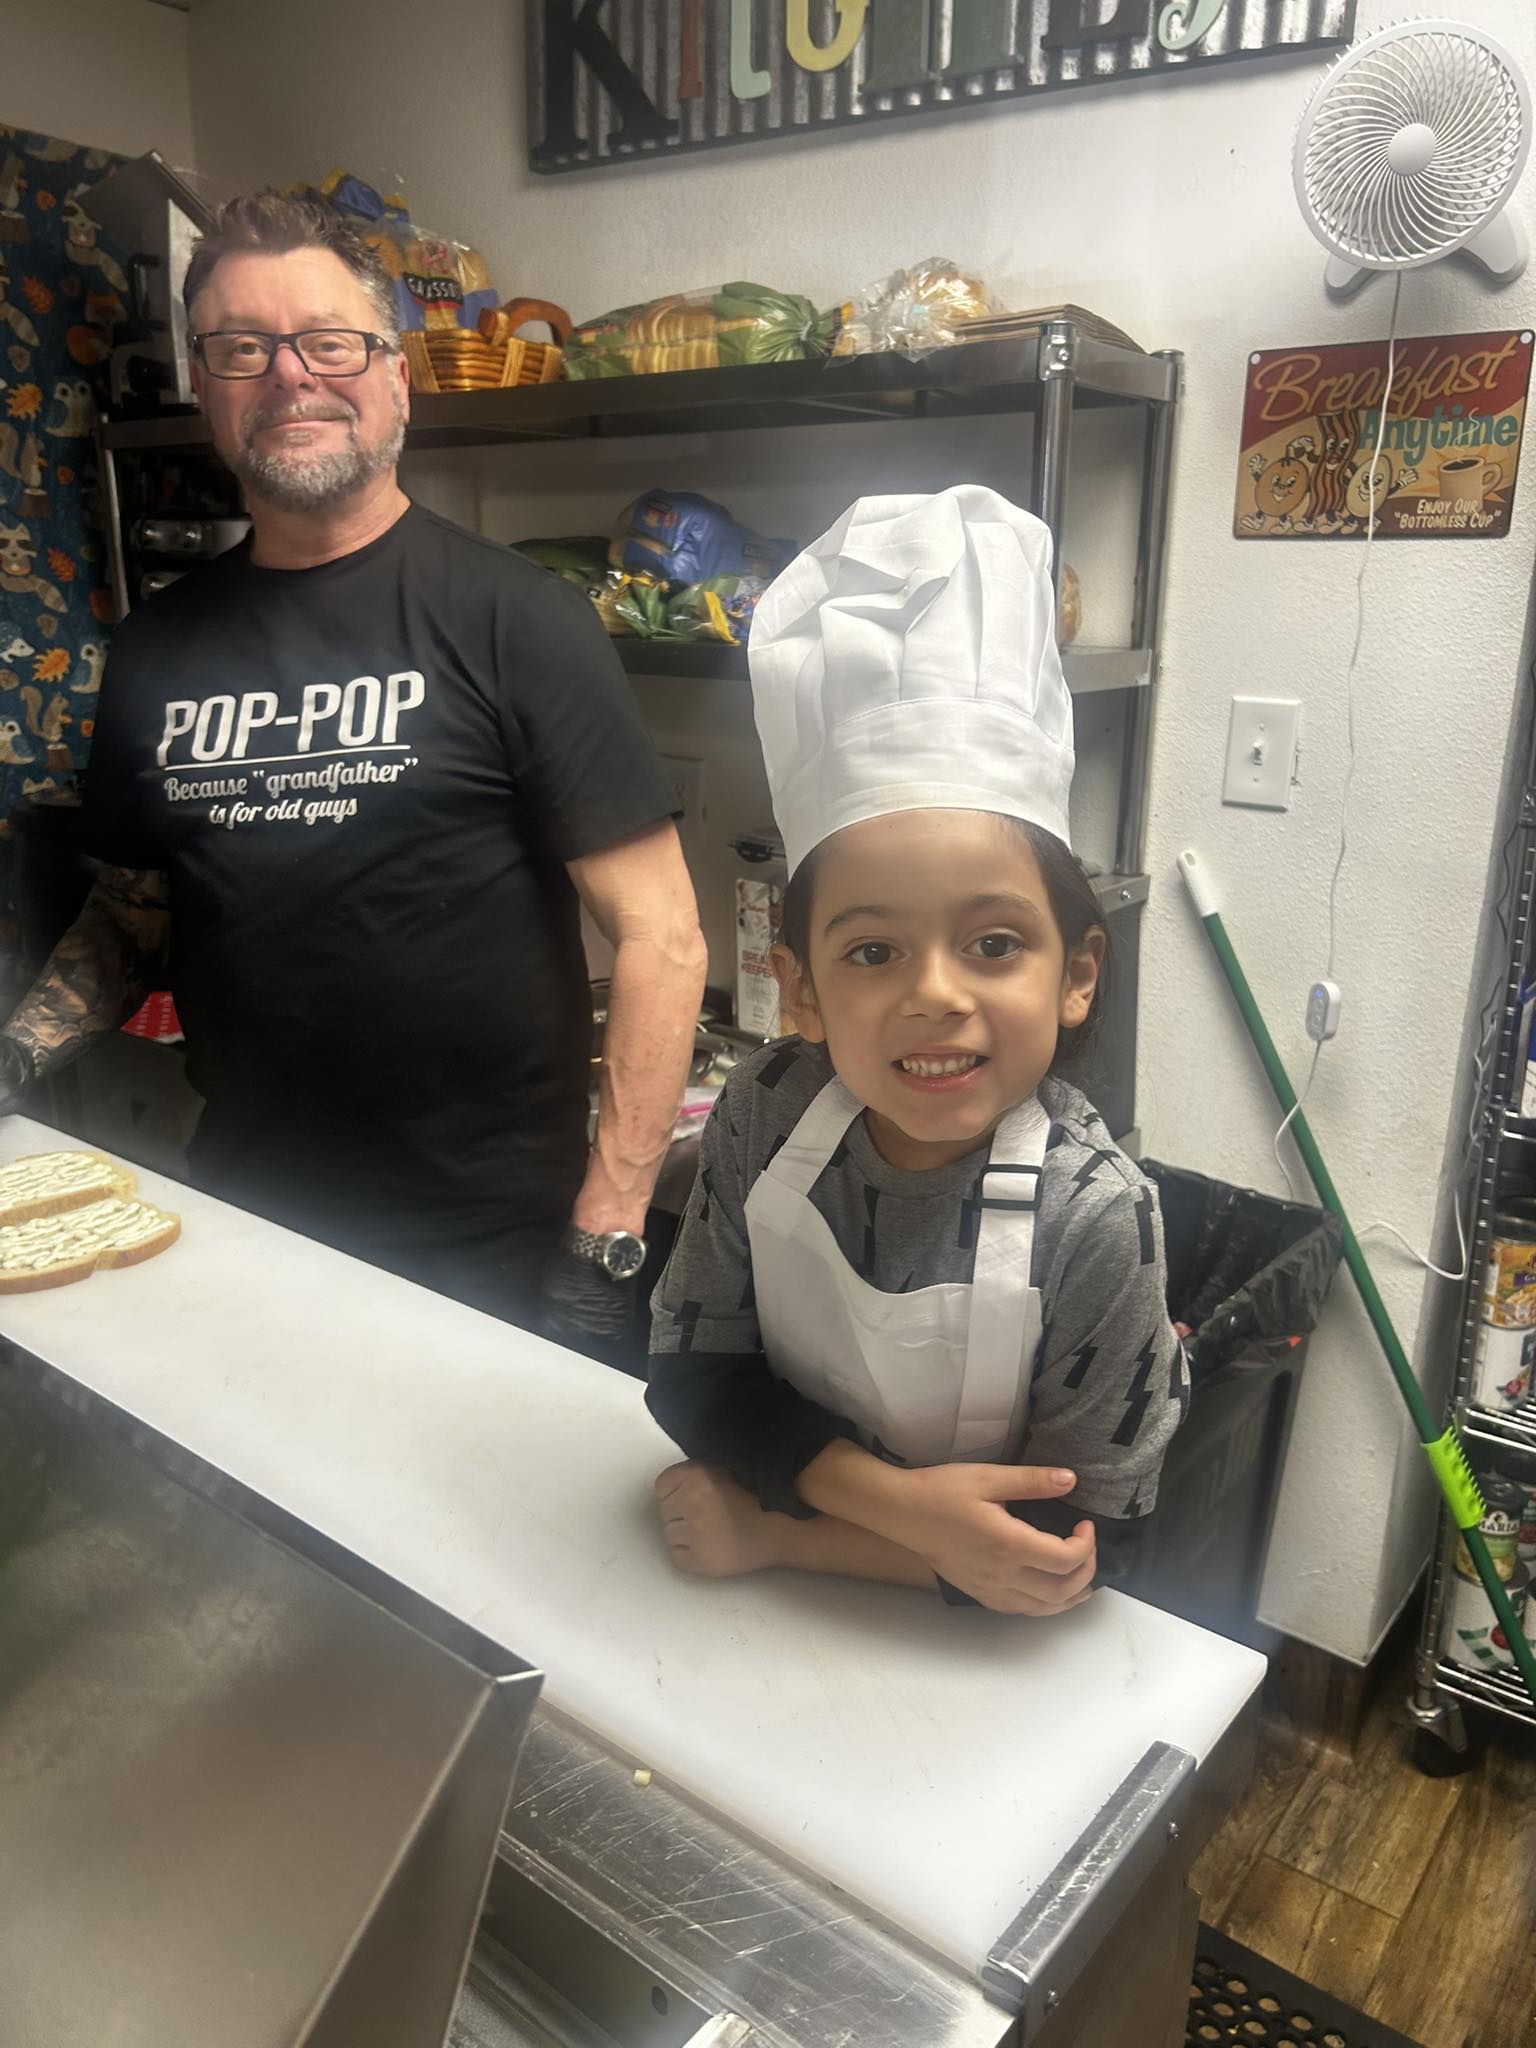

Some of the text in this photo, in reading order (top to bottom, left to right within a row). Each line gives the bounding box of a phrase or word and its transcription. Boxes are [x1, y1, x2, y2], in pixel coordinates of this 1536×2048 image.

[1254, 336, 1518, 419] Breakfast
[1357, 404, 1519, 466] Anytime
[1416, 497, 1479, 515] ENJOY OUR
[156, 670, 426, 767] POP-POP
[164, 776, 248, 802] Because
[209, 797, 358, 830] is for old guys
